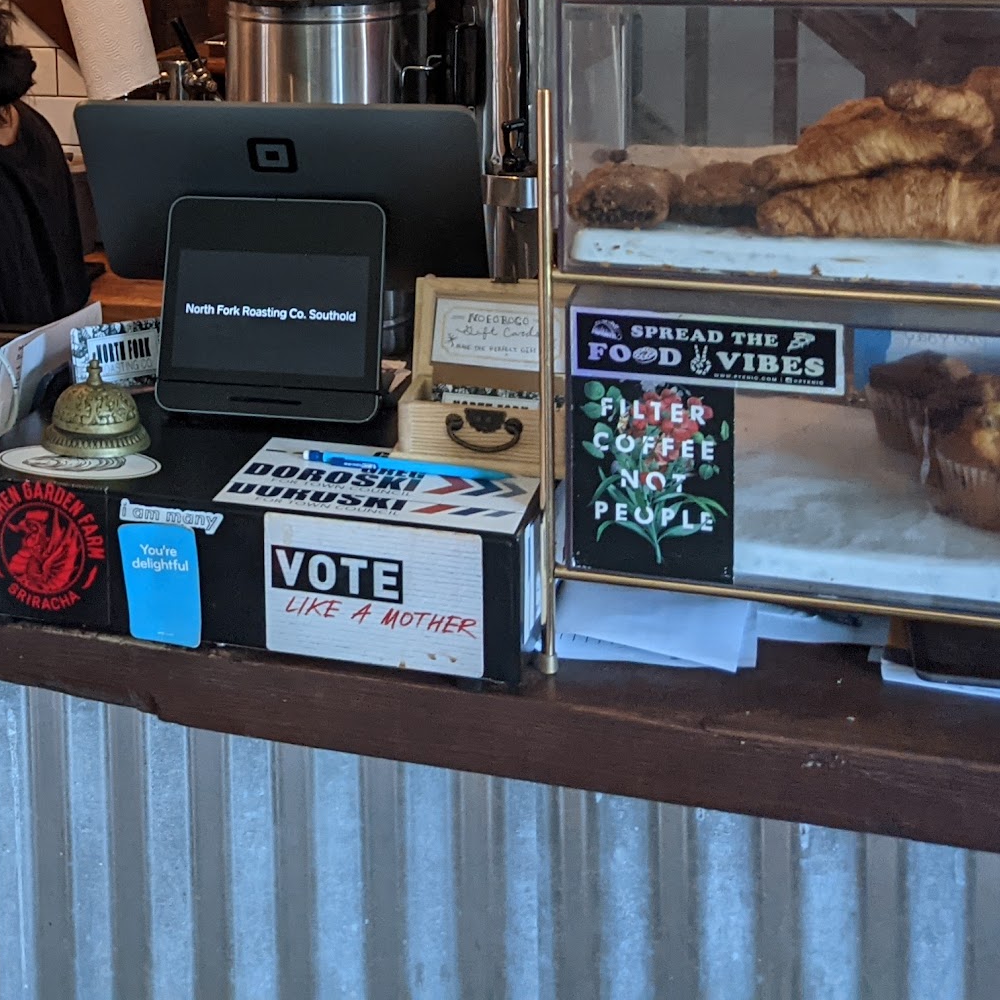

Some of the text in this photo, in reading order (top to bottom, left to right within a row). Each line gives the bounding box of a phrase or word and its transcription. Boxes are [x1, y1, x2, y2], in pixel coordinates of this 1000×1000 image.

[185, 303, 357, 322] North Fork Roasting Co. Southold
[630, 324, 779, 347] SPREAD THE
[96, 337, 151, 364] NORTH FORK
[716, 351, 825, 377] VIBES
[600, 397, 706, 426] FILTER
[593, 432, 714, 461] COFFEE
[243, 461, 423, 491] DOROSKI
[270, 477, 411, 497] FOR TOWN COUNCIL
[621, 469, 687, 493] NOT
[132, 507, 160, 520] am
[166, 511, 217, 531] many
[254, 496, 400, 516] FOR TOWN COUNCIL
[594, 501, 714, 532] PEOPLE
[22, 481, 85, 517] GARDEN
[78, 513, 106, 559] FARM
[139, 544, 177, 557] You're
[132, 557, 189, 572] delightful
[273, 548, 401, 600] VOTE
[8, 583, 81, 611] SRIRACHA
[285, 596, 478, 639] LIKE A MOTHER
